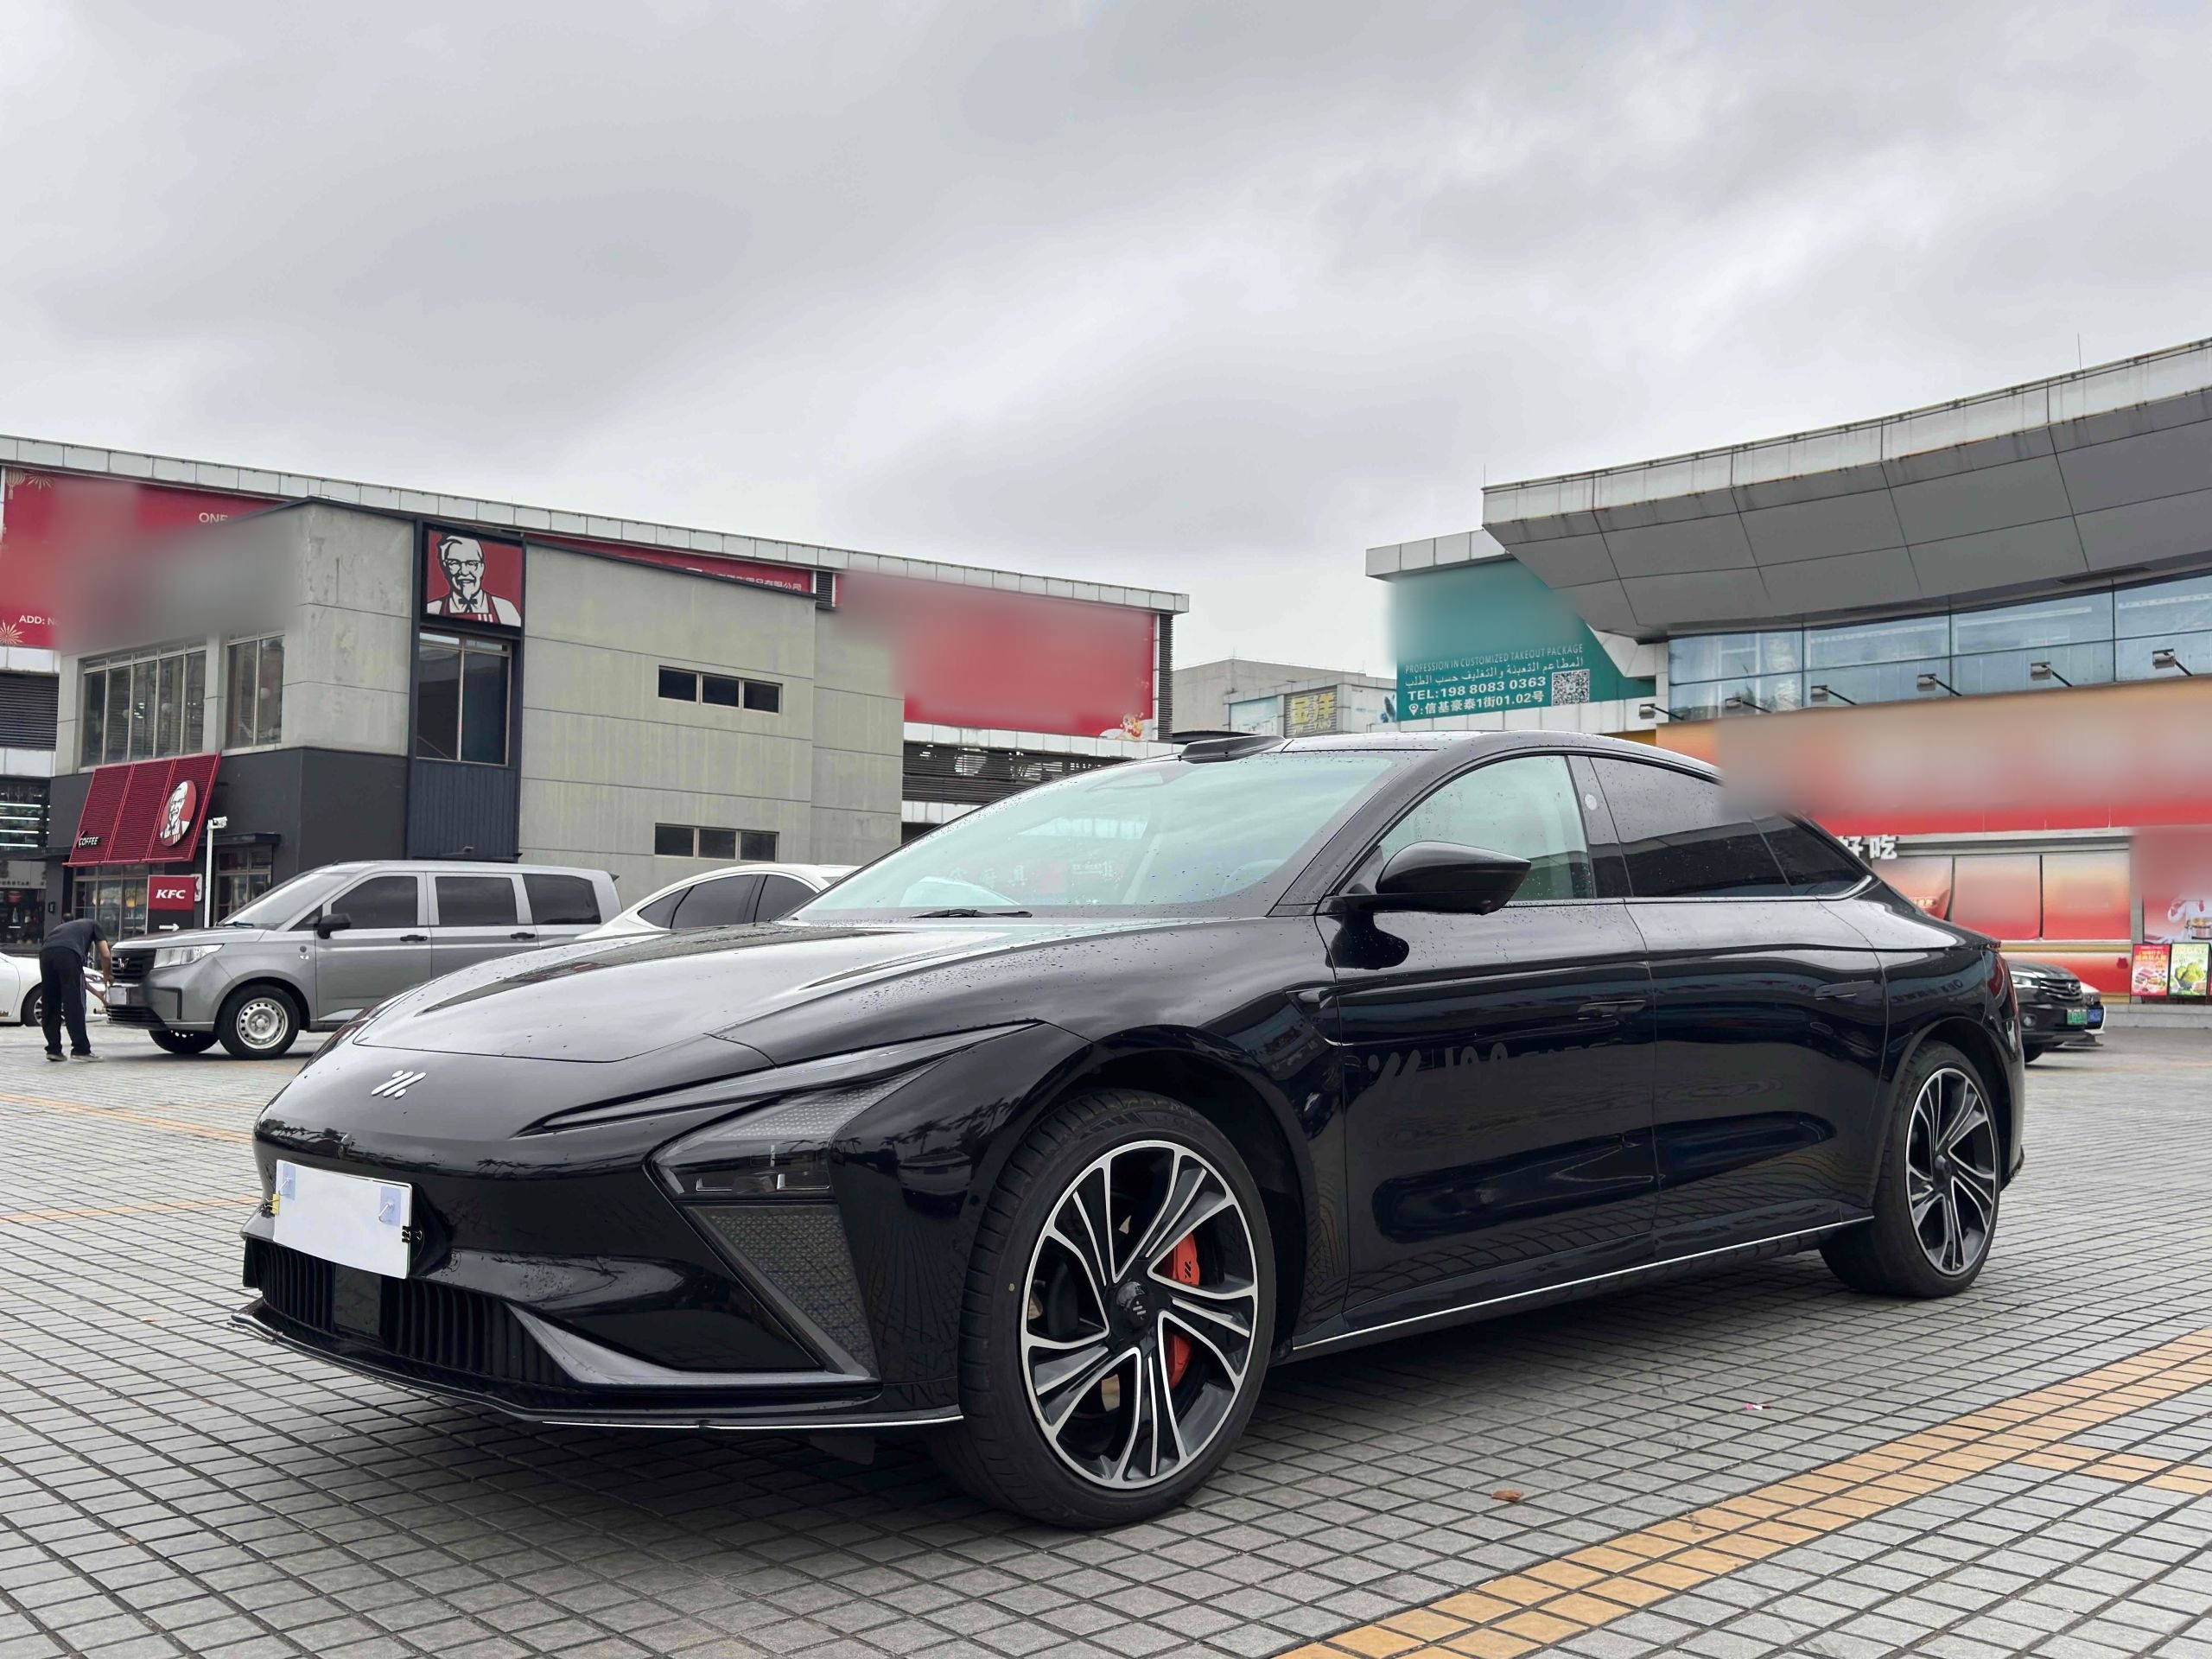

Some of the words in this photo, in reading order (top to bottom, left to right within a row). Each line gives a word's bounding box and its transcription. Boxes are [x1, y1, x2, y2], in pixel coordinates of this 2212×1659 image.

[18, 614, 46, 625] ADD:
[1405, 660, 1449, 674] PROFESSION
[1451, 659, 1459, 669] IN
[1460, 652, 1509, 667] CUSTOMIZED
[1511, 648, 1545, 660] TAKEOUT
[1547, 643, 1583, 657] PACKAGE
[1469, 681, 1505, 694] 8083
[1509, 676, 1546, 690] 0363
[156, 889, 186, 899] KFC
